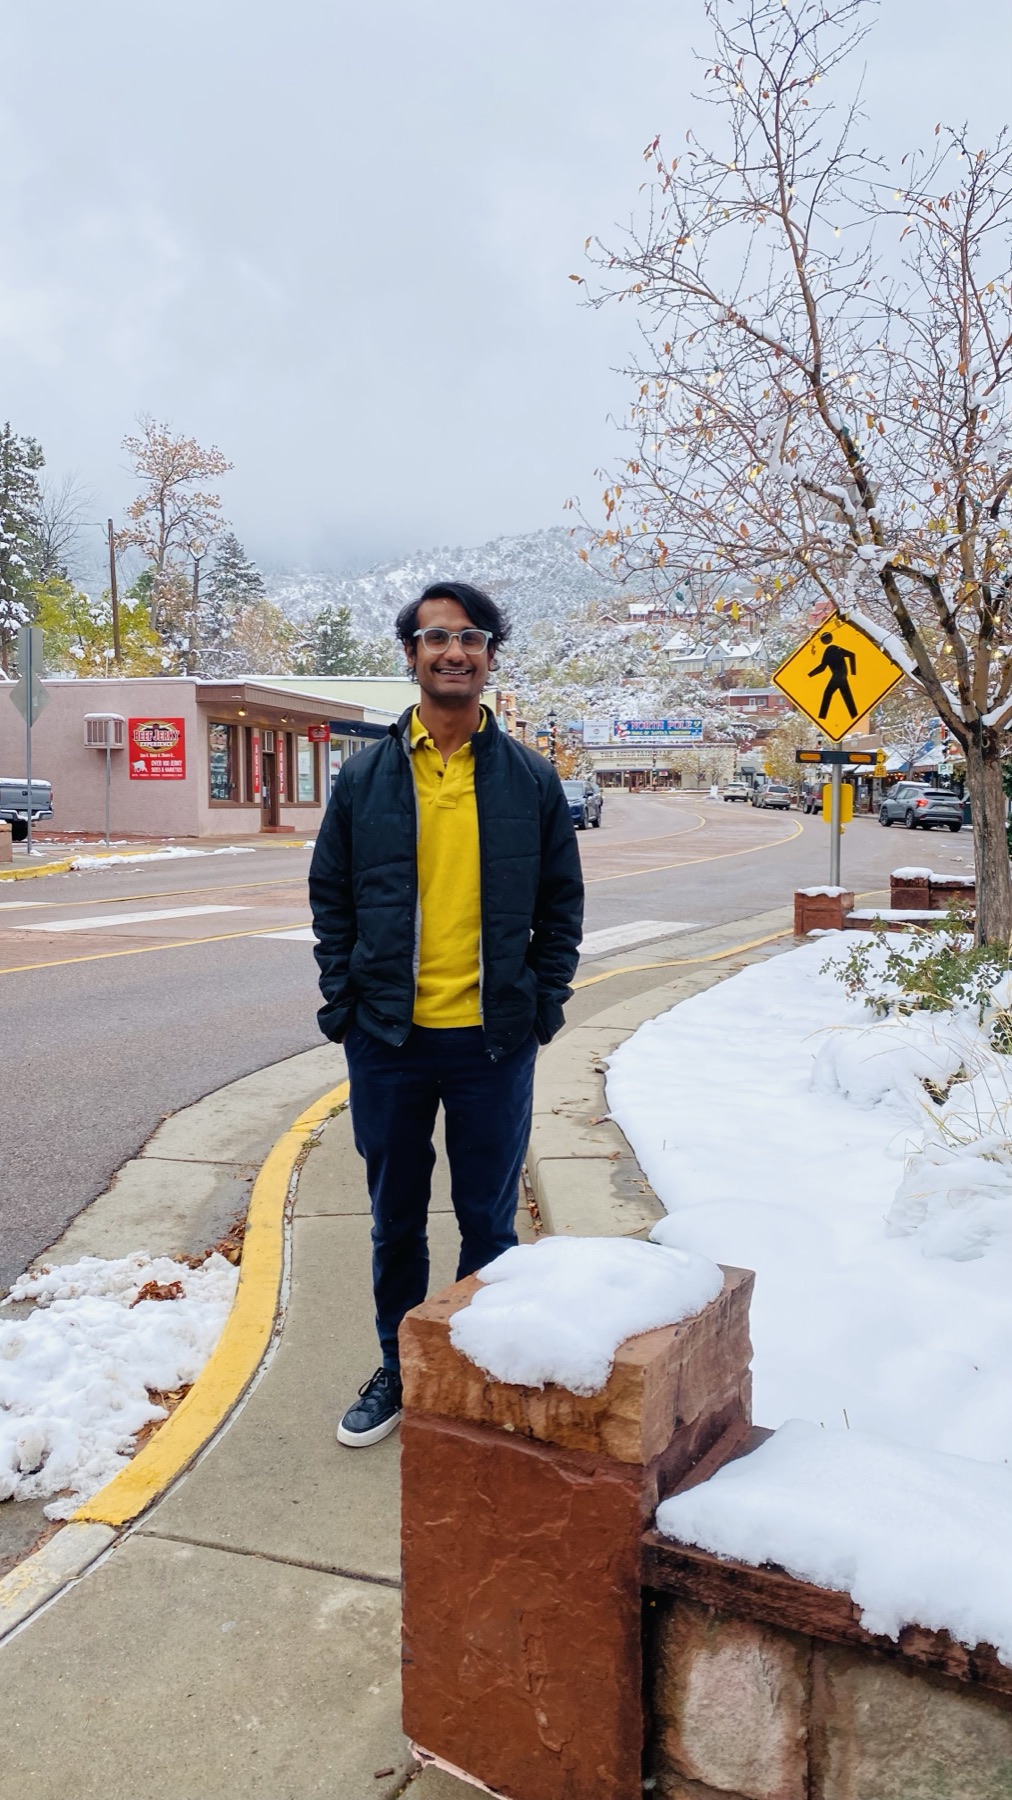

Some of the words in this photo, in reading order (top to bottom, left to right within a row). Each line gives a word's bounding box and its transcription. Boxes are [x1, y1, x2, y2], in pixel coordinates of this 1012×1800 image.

[631, 721, 664, 730] NORTH
[667, 721, 692, 730] POLE
[133, 730, 152, 741] BEEF
[153, 730, 180, 741] JERKY
